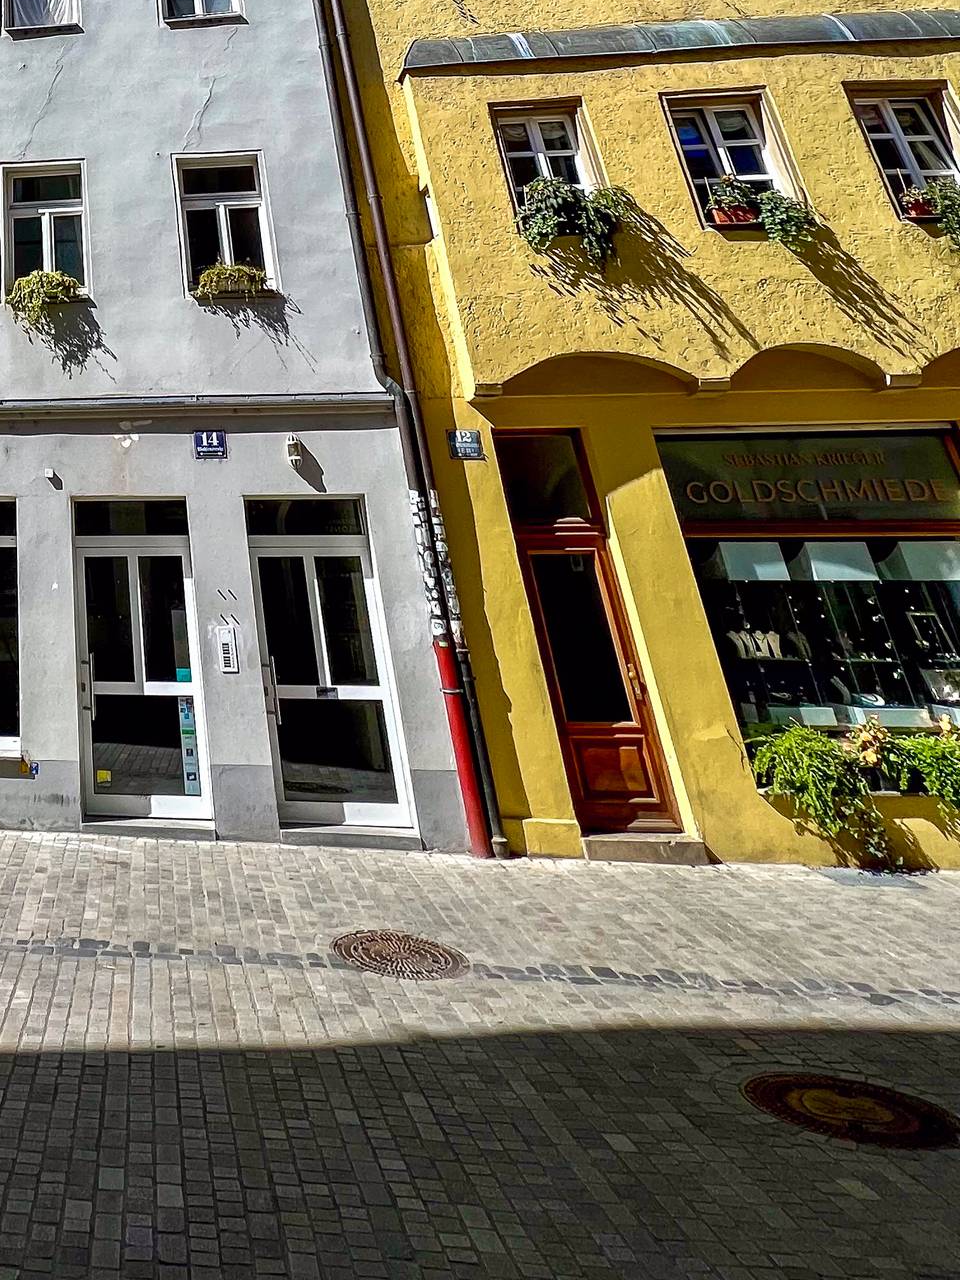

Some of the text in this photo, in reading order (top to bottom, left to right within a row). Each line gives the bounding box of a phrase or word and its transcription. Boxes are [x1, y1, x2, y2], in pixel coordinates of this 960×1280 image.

[200, 431, 220, 447] 14
[455, 430, 472, 443] 12
[814, 450, 887, 465] KRIEGER
[686, 478, 951, 504] GOLDSCHMIEDE
